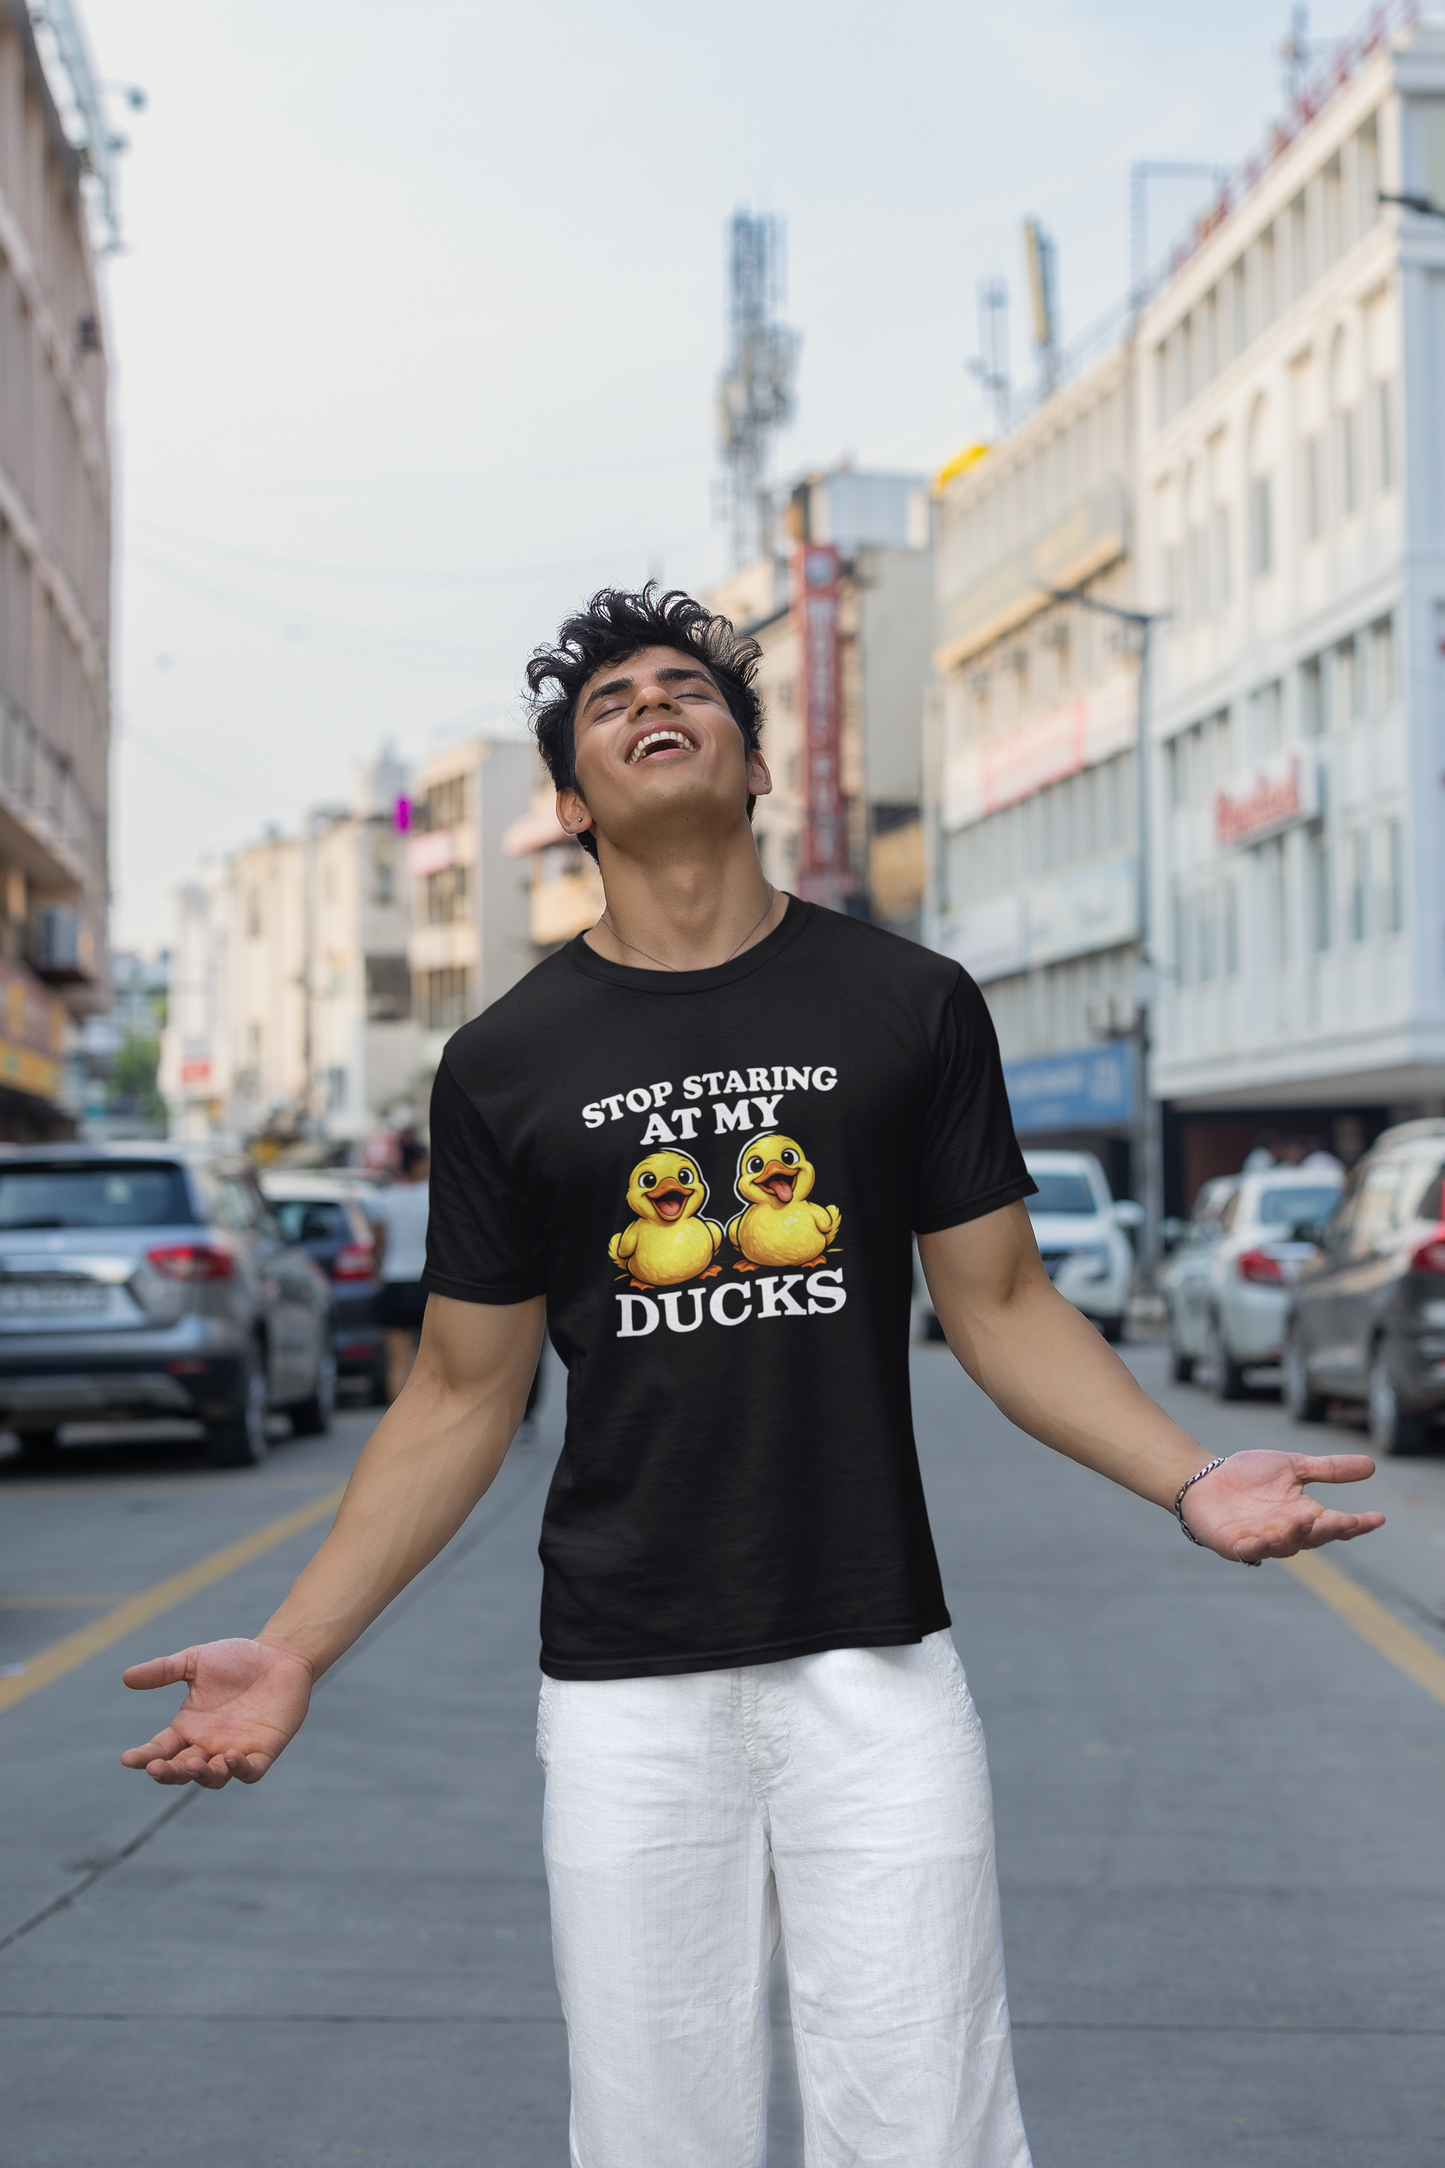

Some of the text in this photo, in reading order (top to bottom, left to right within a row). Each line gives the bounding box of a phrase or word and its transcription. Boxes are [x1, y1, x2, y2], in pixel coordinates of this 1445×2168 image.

[582, 1066, 838, 1129] STOP STARING
[640, 1094, 784, 1146] AT MY
[615, 1267, 847, 1338] DUCKS
